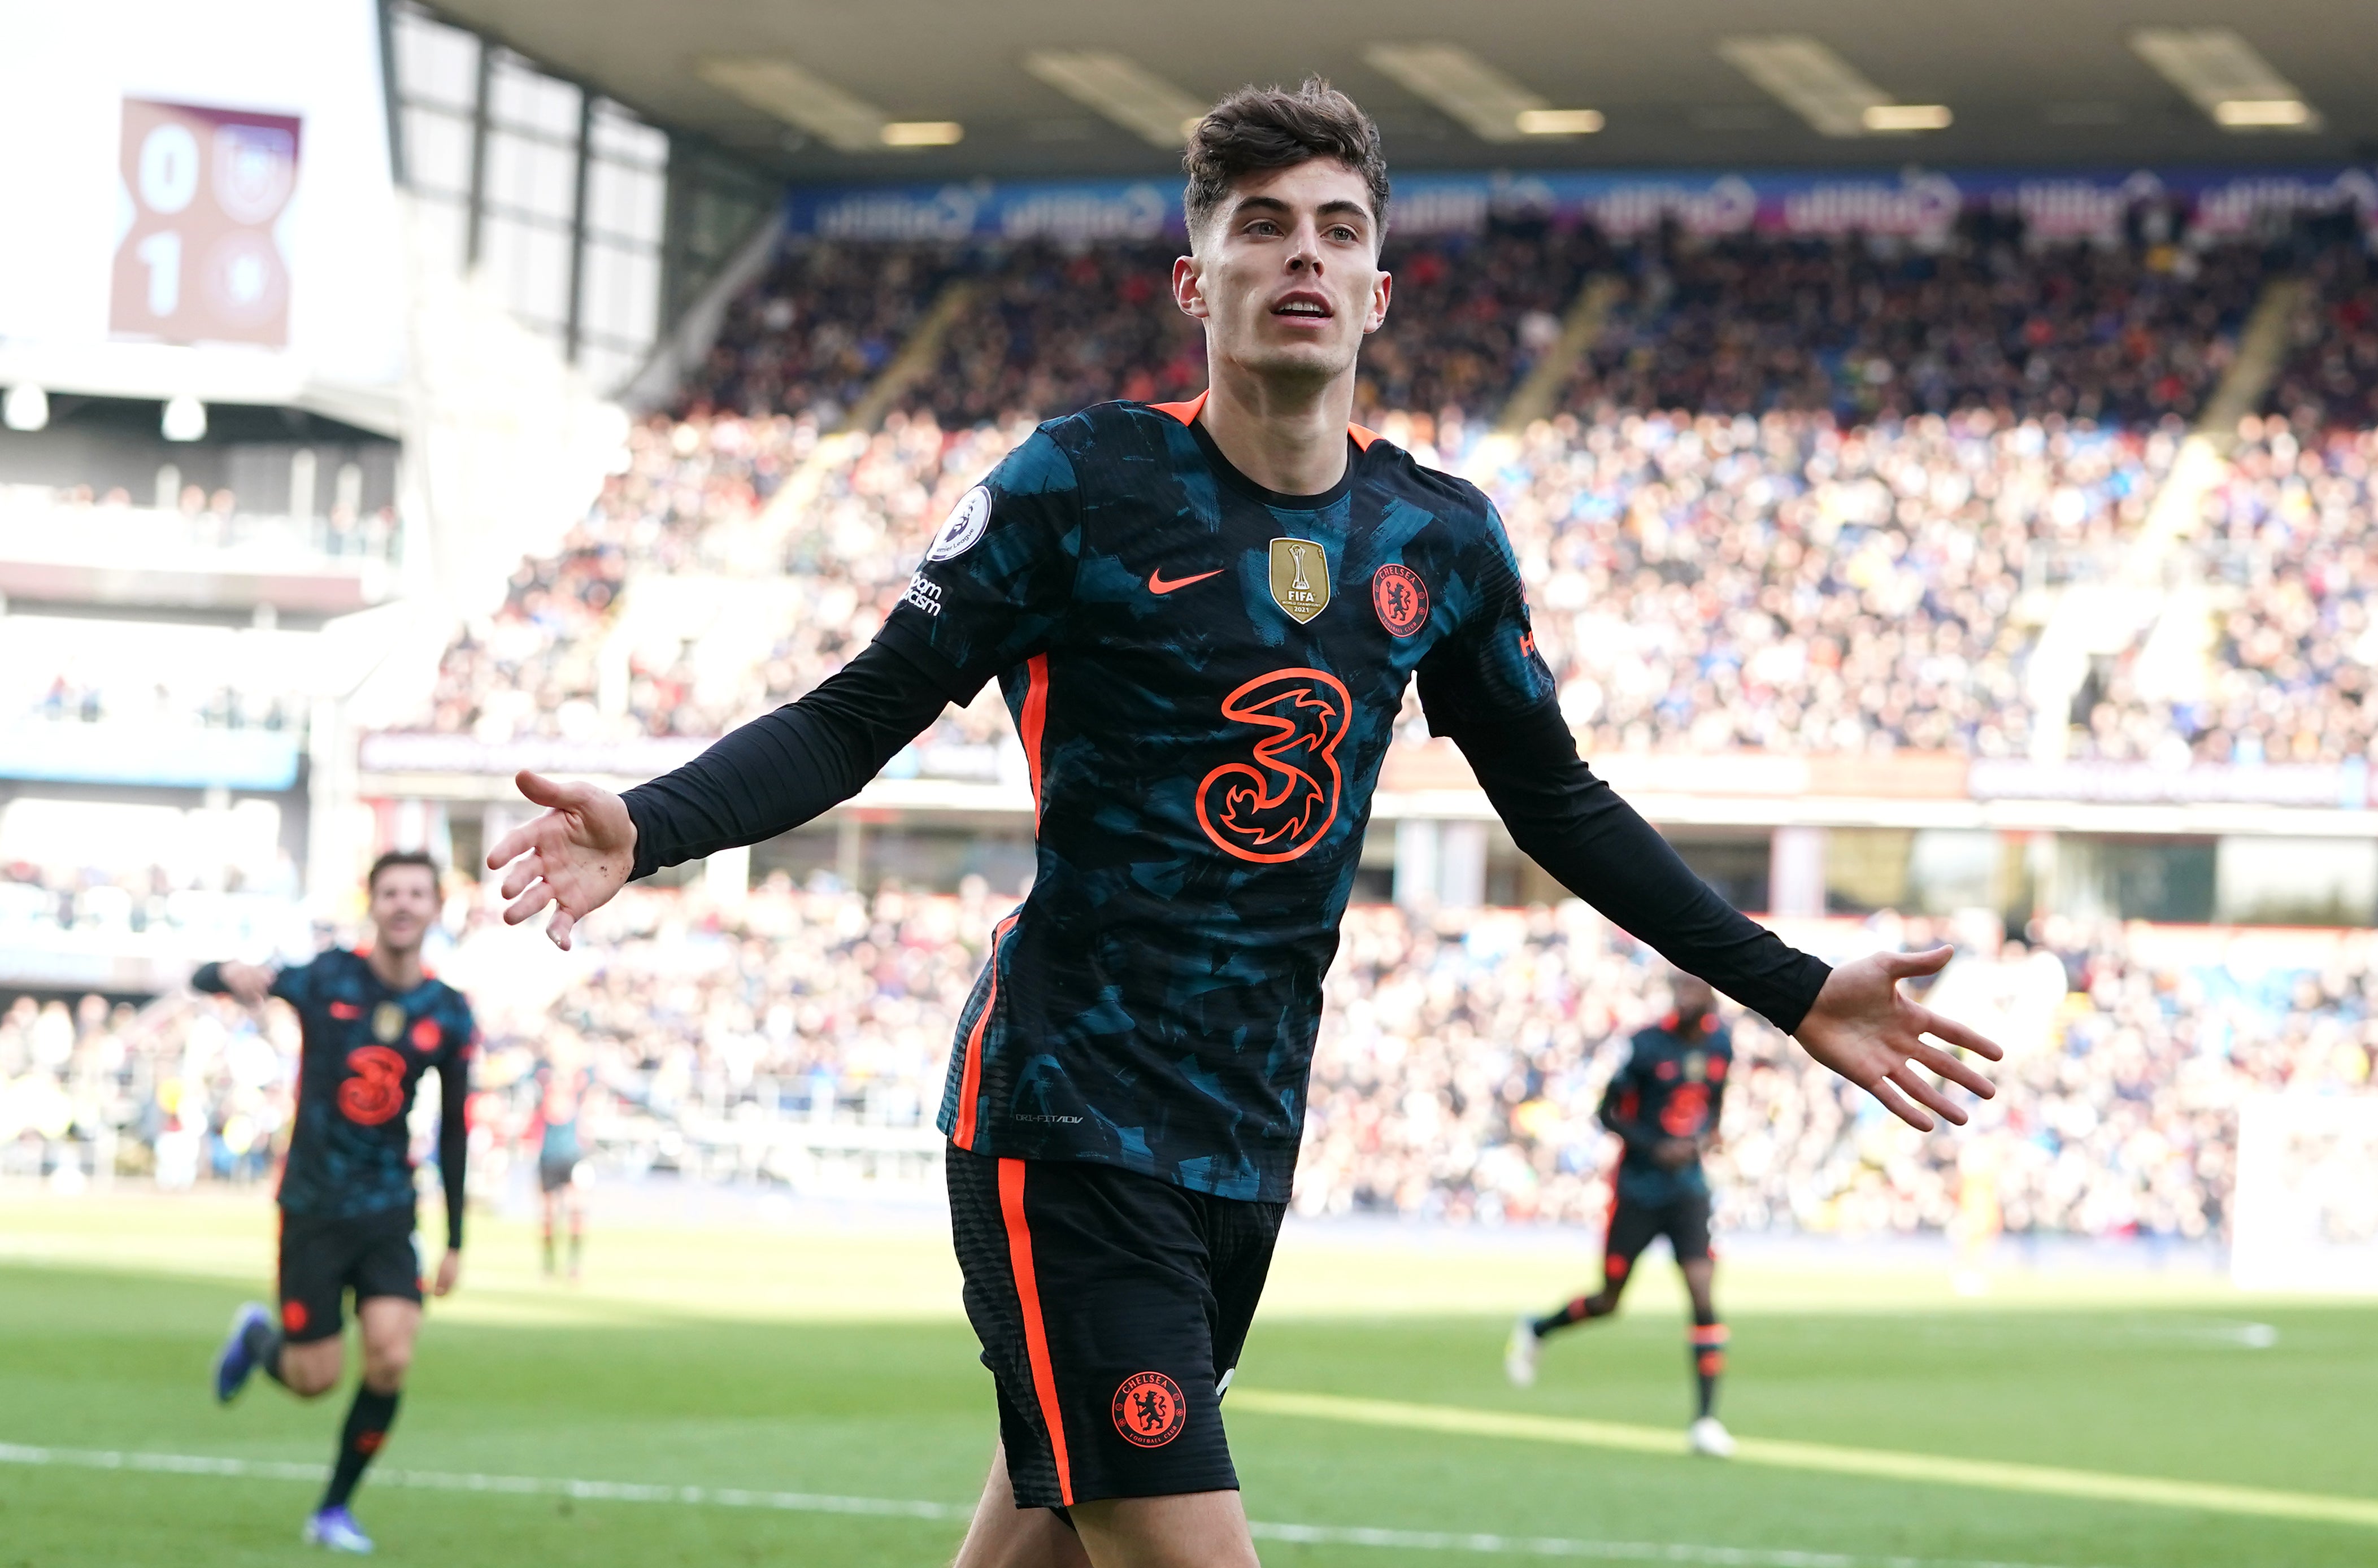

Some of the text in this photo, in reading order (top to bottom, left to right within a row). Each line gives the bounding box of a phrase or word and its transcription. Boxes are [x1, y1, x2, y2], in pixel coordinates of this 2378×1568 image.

[137, 120, 200, 216] 0
[134, 227, 182, 319] 1
[953, 528, 975, 548] League
[1379, 567, 1416, 583] CHELSEA
[1289, 591, 1314, 602] FIFA
[1405, 622, 1417, 632] CLUB
[1195, 667, 1352, 864] 3
[339, 1045, 406, 1125] 3
[1122, 1375, 1168, 1394] CHELSEA
[1130, 1425, 1177, 1443] FOOTBALL CLUB
